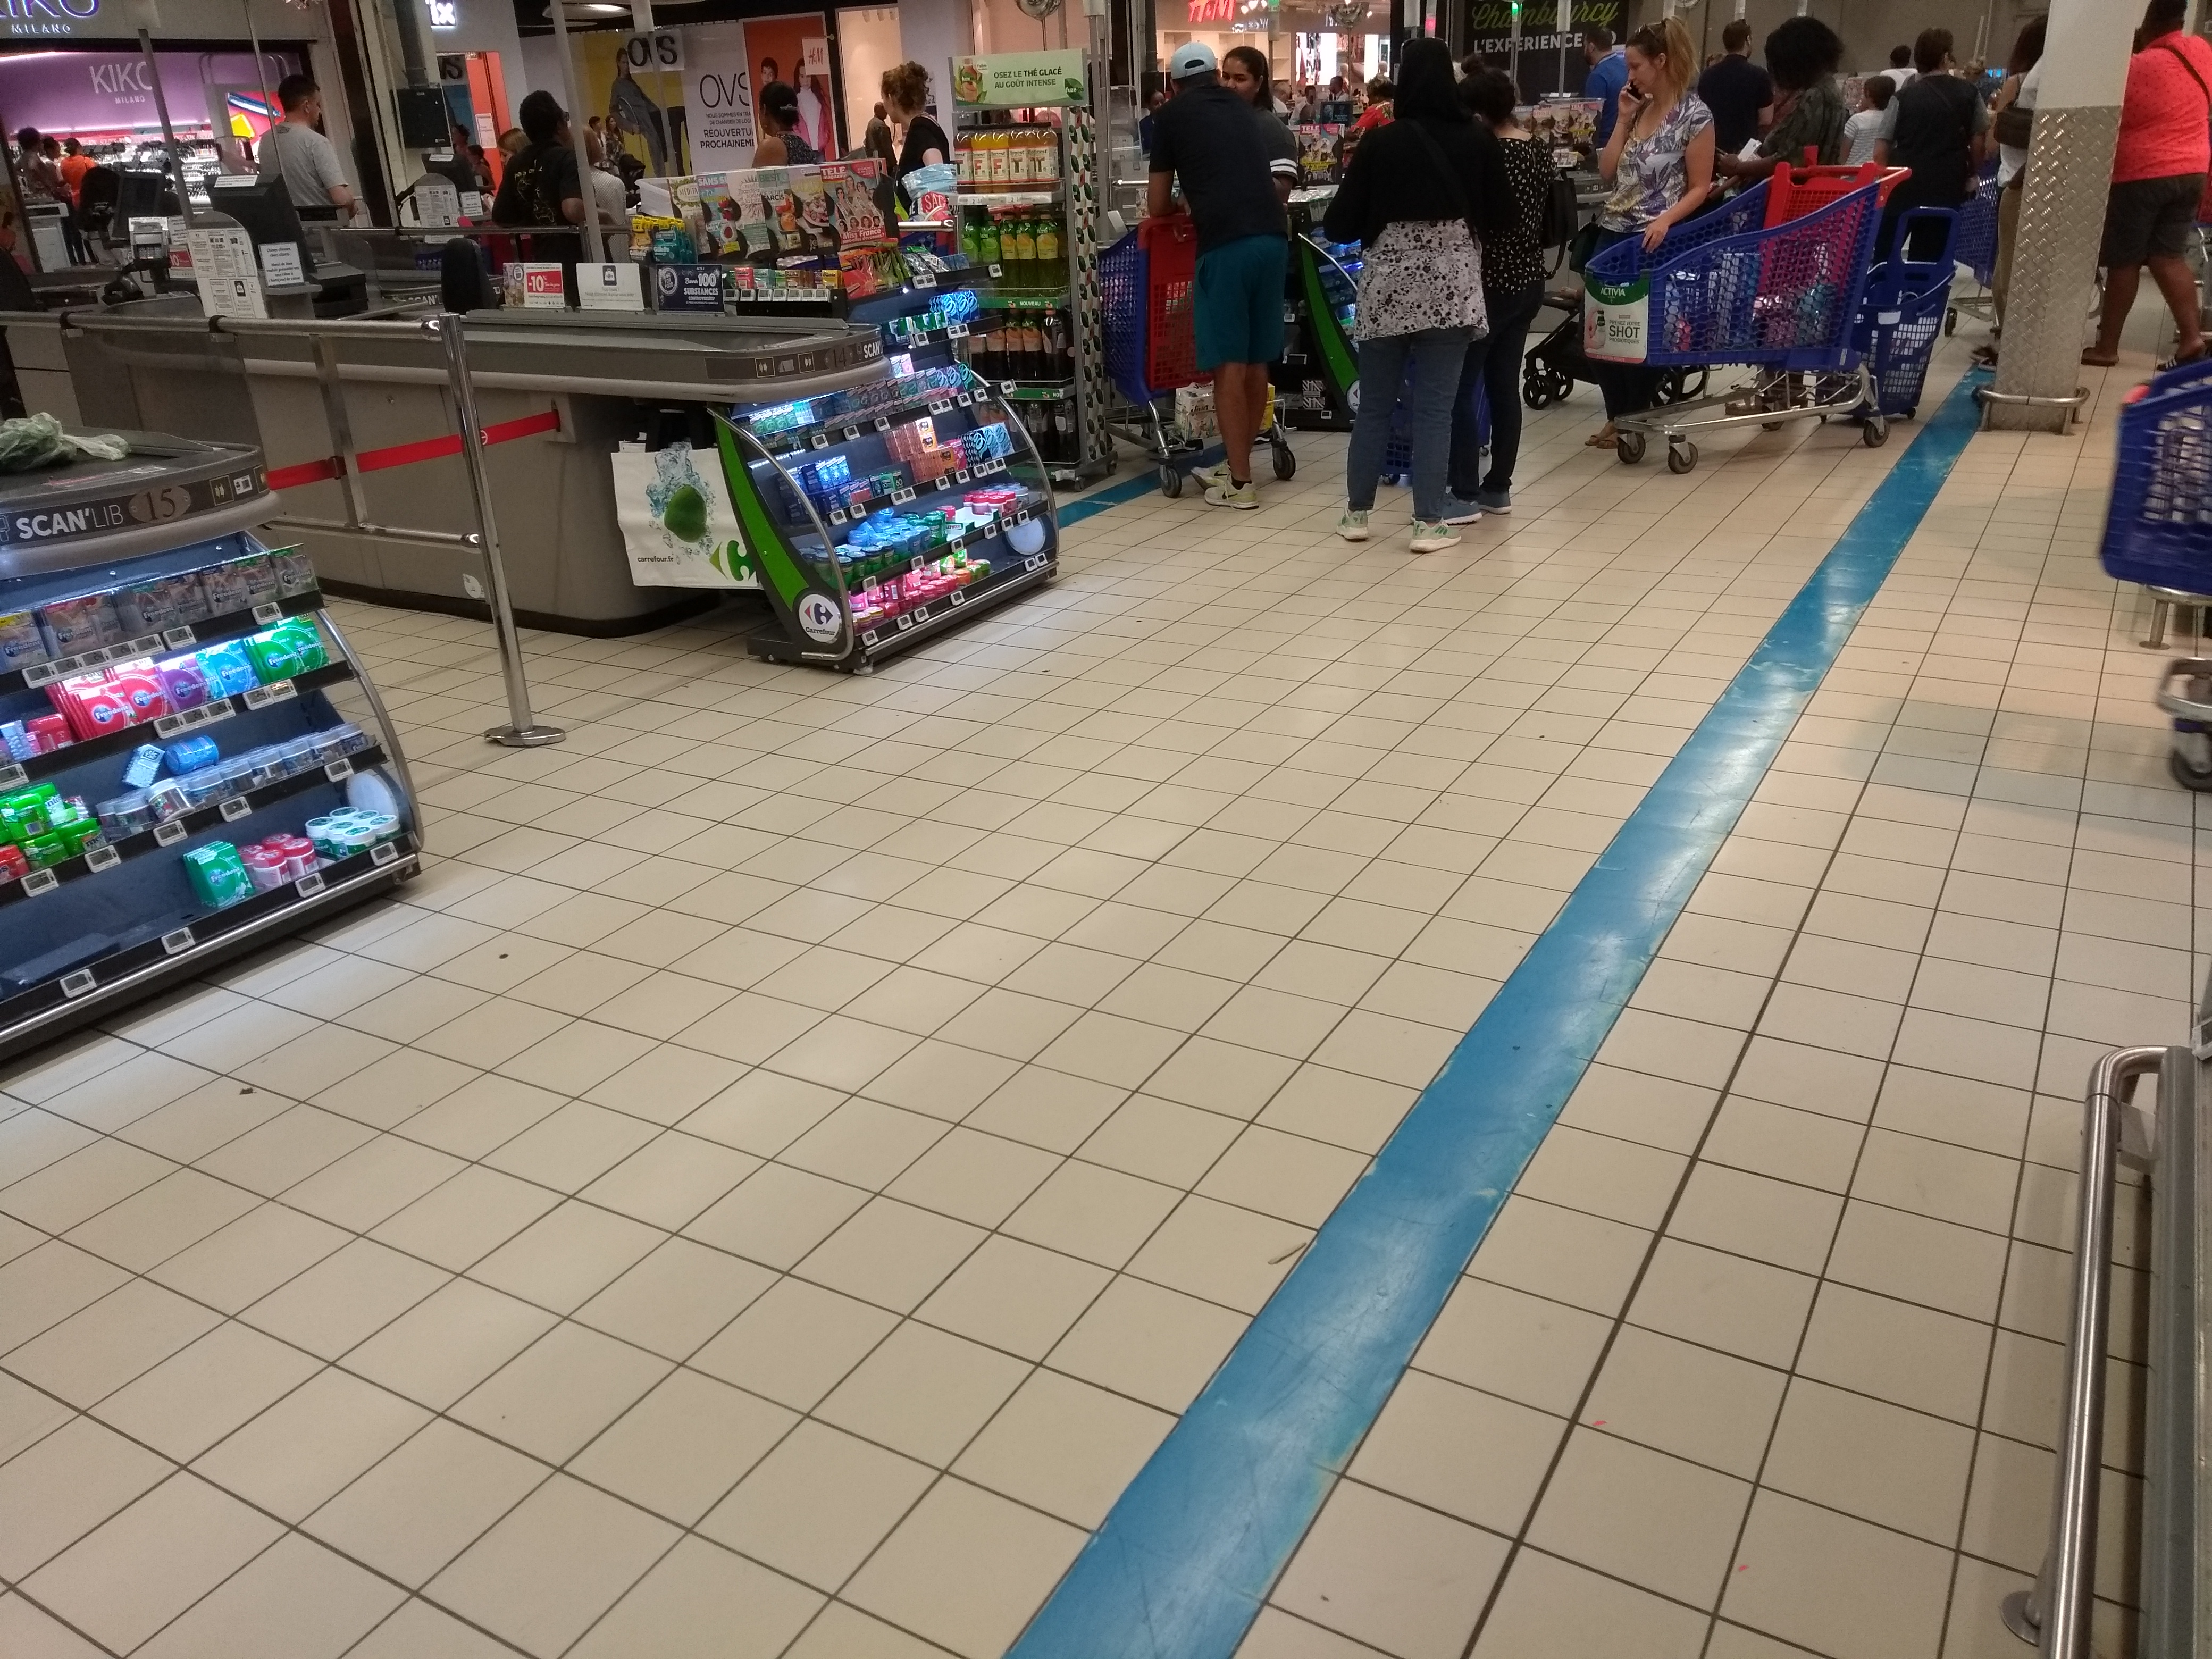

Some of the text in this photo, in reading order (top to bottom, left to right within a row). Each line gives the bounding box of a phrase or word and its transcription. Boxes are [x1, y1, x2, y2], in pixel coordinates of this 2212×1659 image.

[1472, 1, 1619, 30] Chamburcy
[12, 24, 71, 33] MILANO
[1024, 68, 1037, 77] THÉ
[1038, 66, 1062, 76] GLACÉ
[115, 95, 145, 104] MILANO
[859, 229, 881, 237] France
[698, 273, 717, 287] 100
[1601, 287, 1626, 296] ACTIVIA
[1609, 325, 1640, 338] SHOT
[834, 348, 847, 368] 14
[16, 488, 175, 539] SCAN'LIB 15
[144, 605, 175, 619] Freedent
[806, 627, 835, 635] Carrefour
[5, 639, 43, 655] Freedent
[269, 651, 297, 665] Freedent
[95, 705, 129, 719] Freedent
